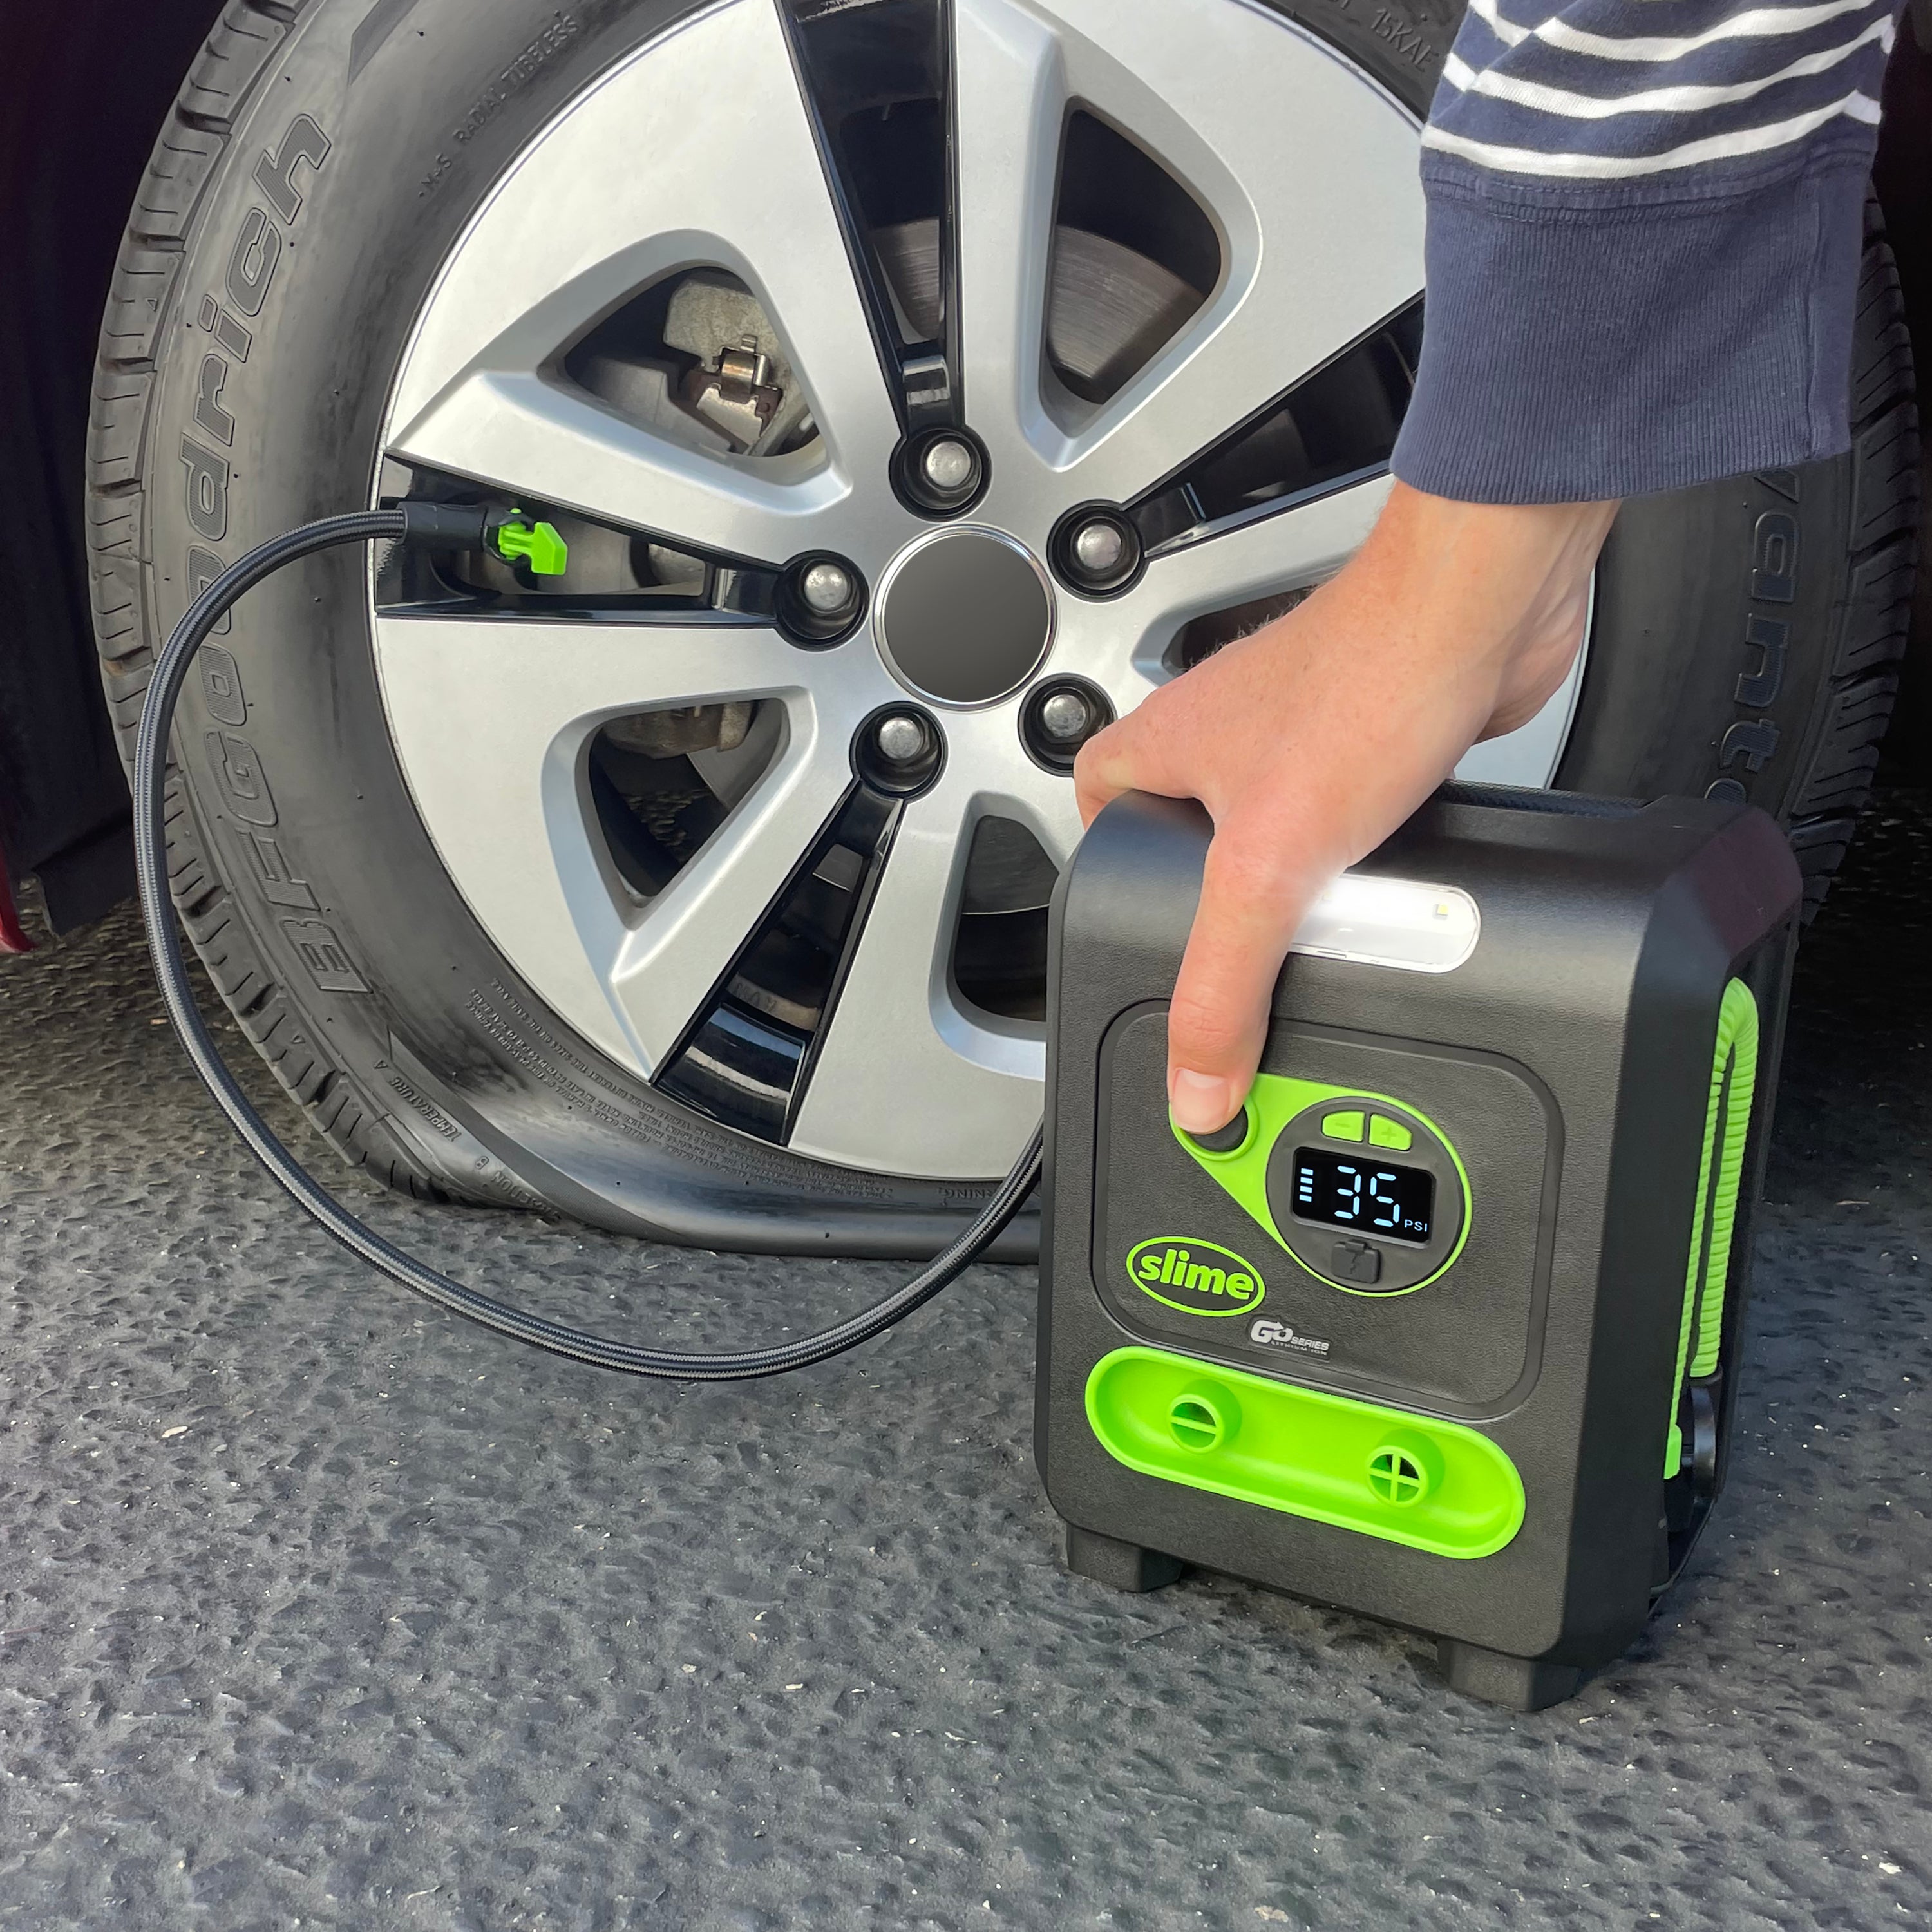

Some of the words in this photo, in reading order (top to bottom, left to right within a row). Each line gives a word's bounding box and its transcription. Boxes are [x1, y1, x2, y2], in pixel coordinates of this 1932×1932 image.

[452, 86, 506, 144] RADIAL
[501, 15, 578, 88] TUBELESS
[388, 1076, 462, 1142] TEMPERATURE
[475, 1155, 490, 1170] B
[1334, 1166, 1400, 1227] 35
[1404, 1219, 1428, 1233] PSI
[1138, 1249, 1255, 1300] slime
[1290, 1336, 1330, 1350] SERIES
